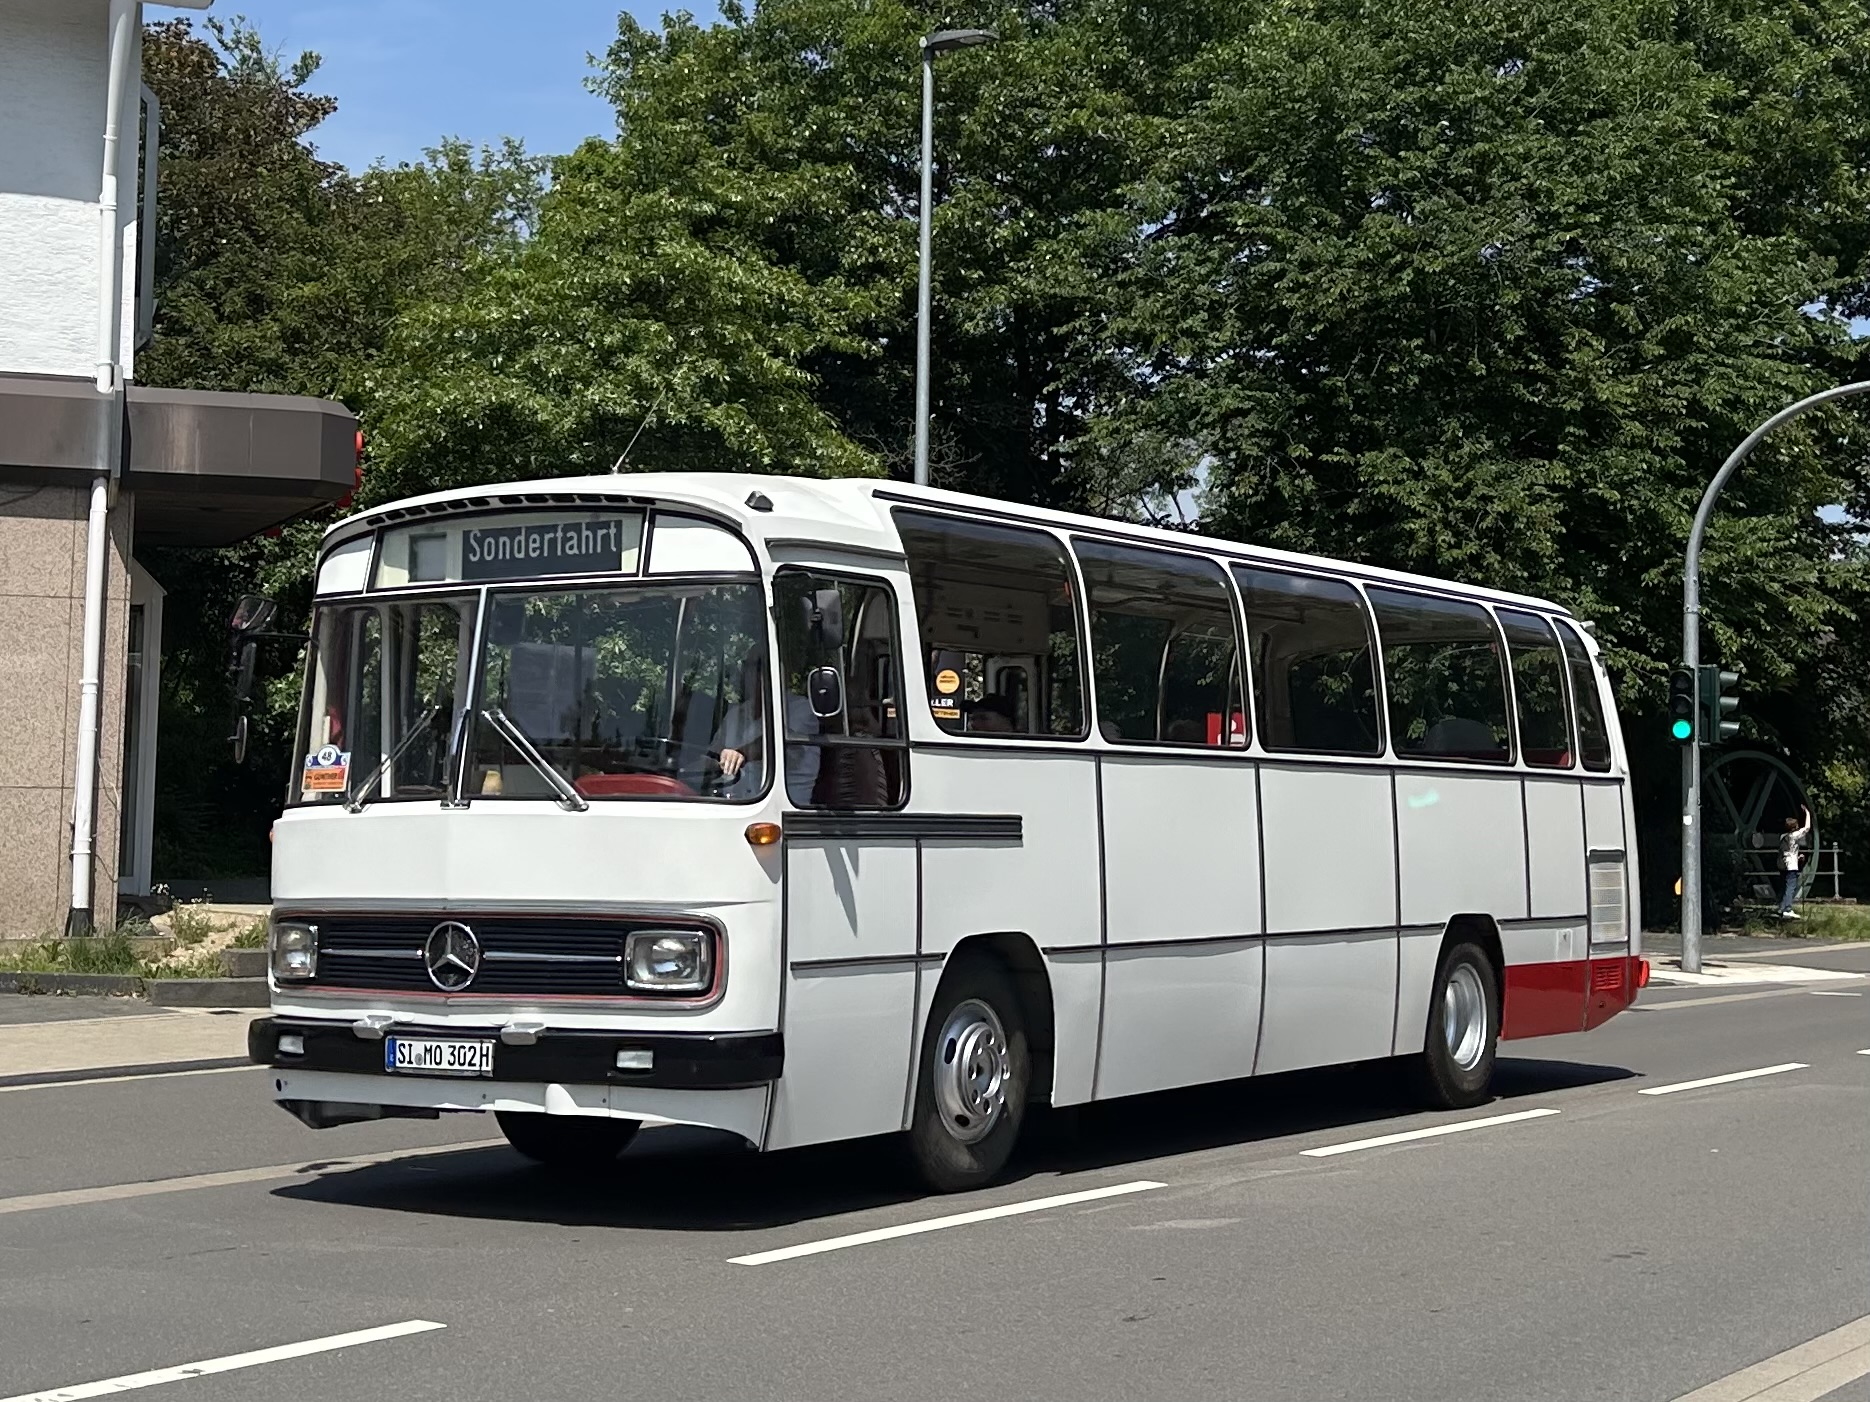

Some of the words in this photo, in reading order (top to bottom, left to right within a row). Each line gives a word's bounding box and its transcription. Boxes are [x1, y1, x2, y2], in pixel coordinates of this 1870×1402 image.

[469, 521, 617, 561] Sonderfahrt
[321, 751, 333, 761] 48
[398, 1043, 413, 1065] SI
[423, 1044, 443, 1066] MO
